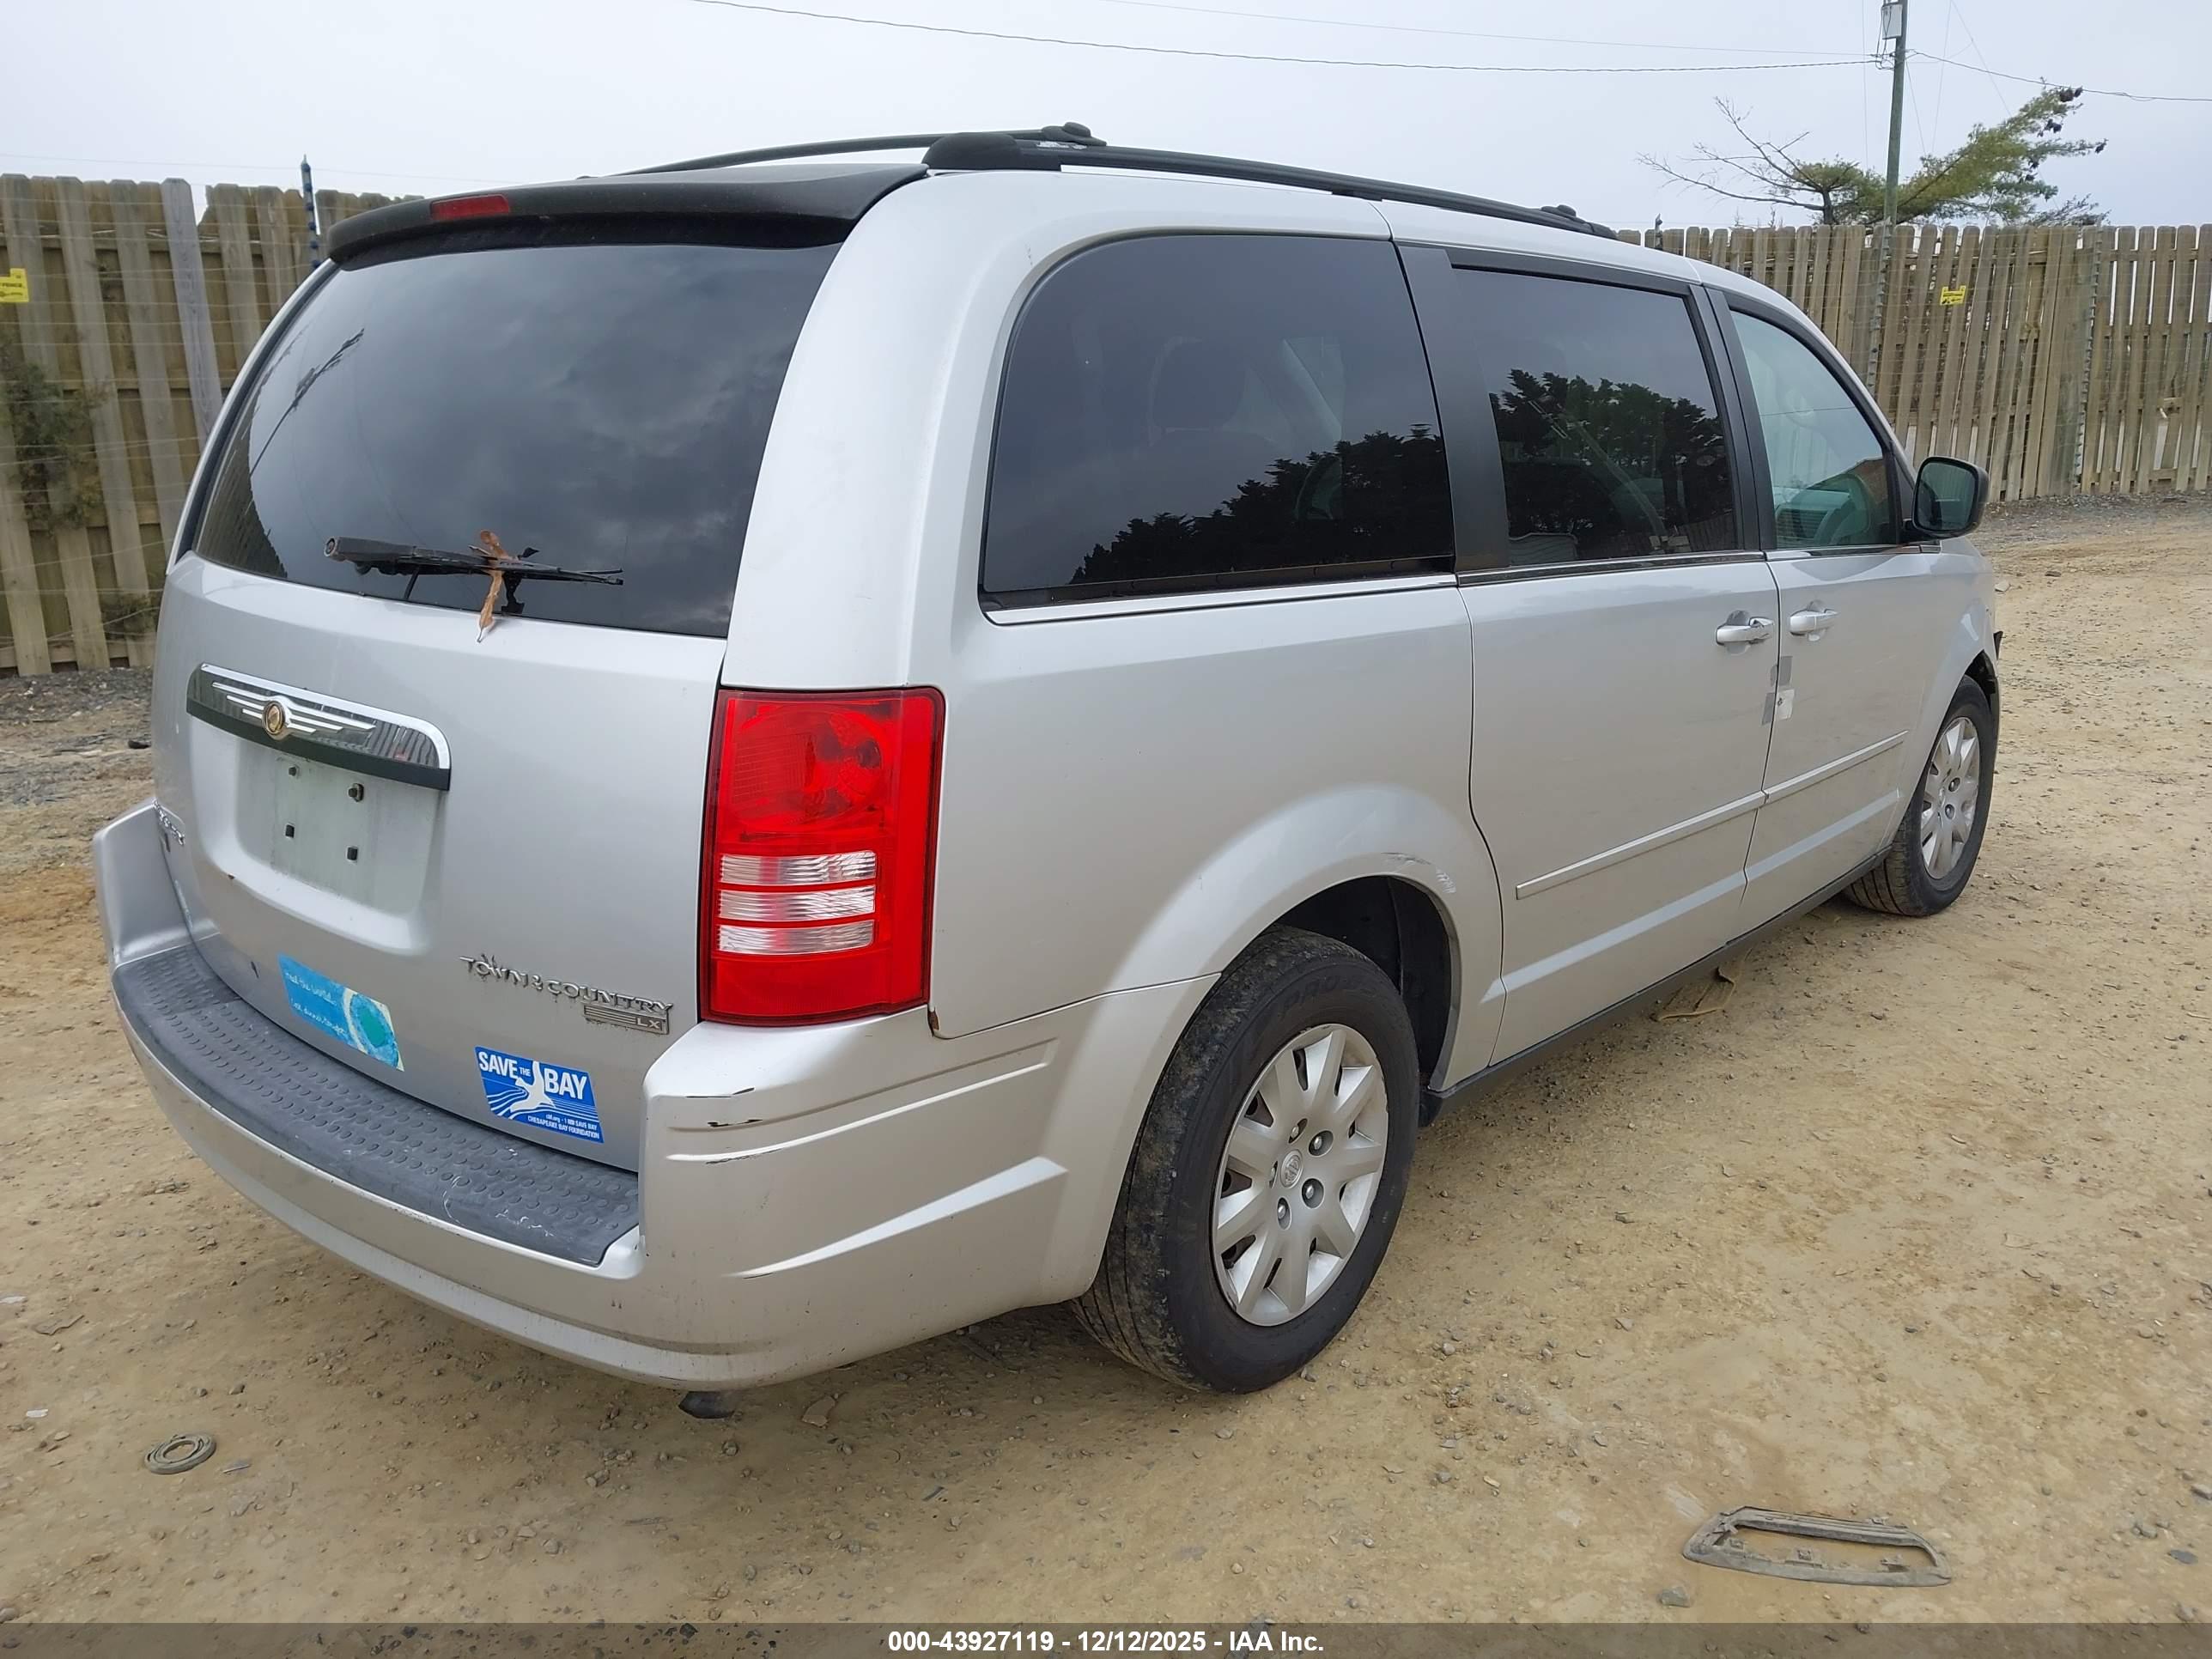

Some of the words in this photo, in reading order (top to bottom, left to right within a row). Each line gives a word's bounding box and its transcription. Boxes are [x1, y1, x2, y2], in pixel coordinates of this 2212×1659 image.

[637, 1018, 660, 1030] LX
[478, 1051, 519, 1079] SAVE
[519, 1066, 532, 1077] THE
[544, 1067, 587, 1099] BAY
[527, 1115, 558, 1129] CHESAPEAKE
[558, 1123, 568, 1132] BAY
[568, 1126, 600, 1139] FOUNDATION
